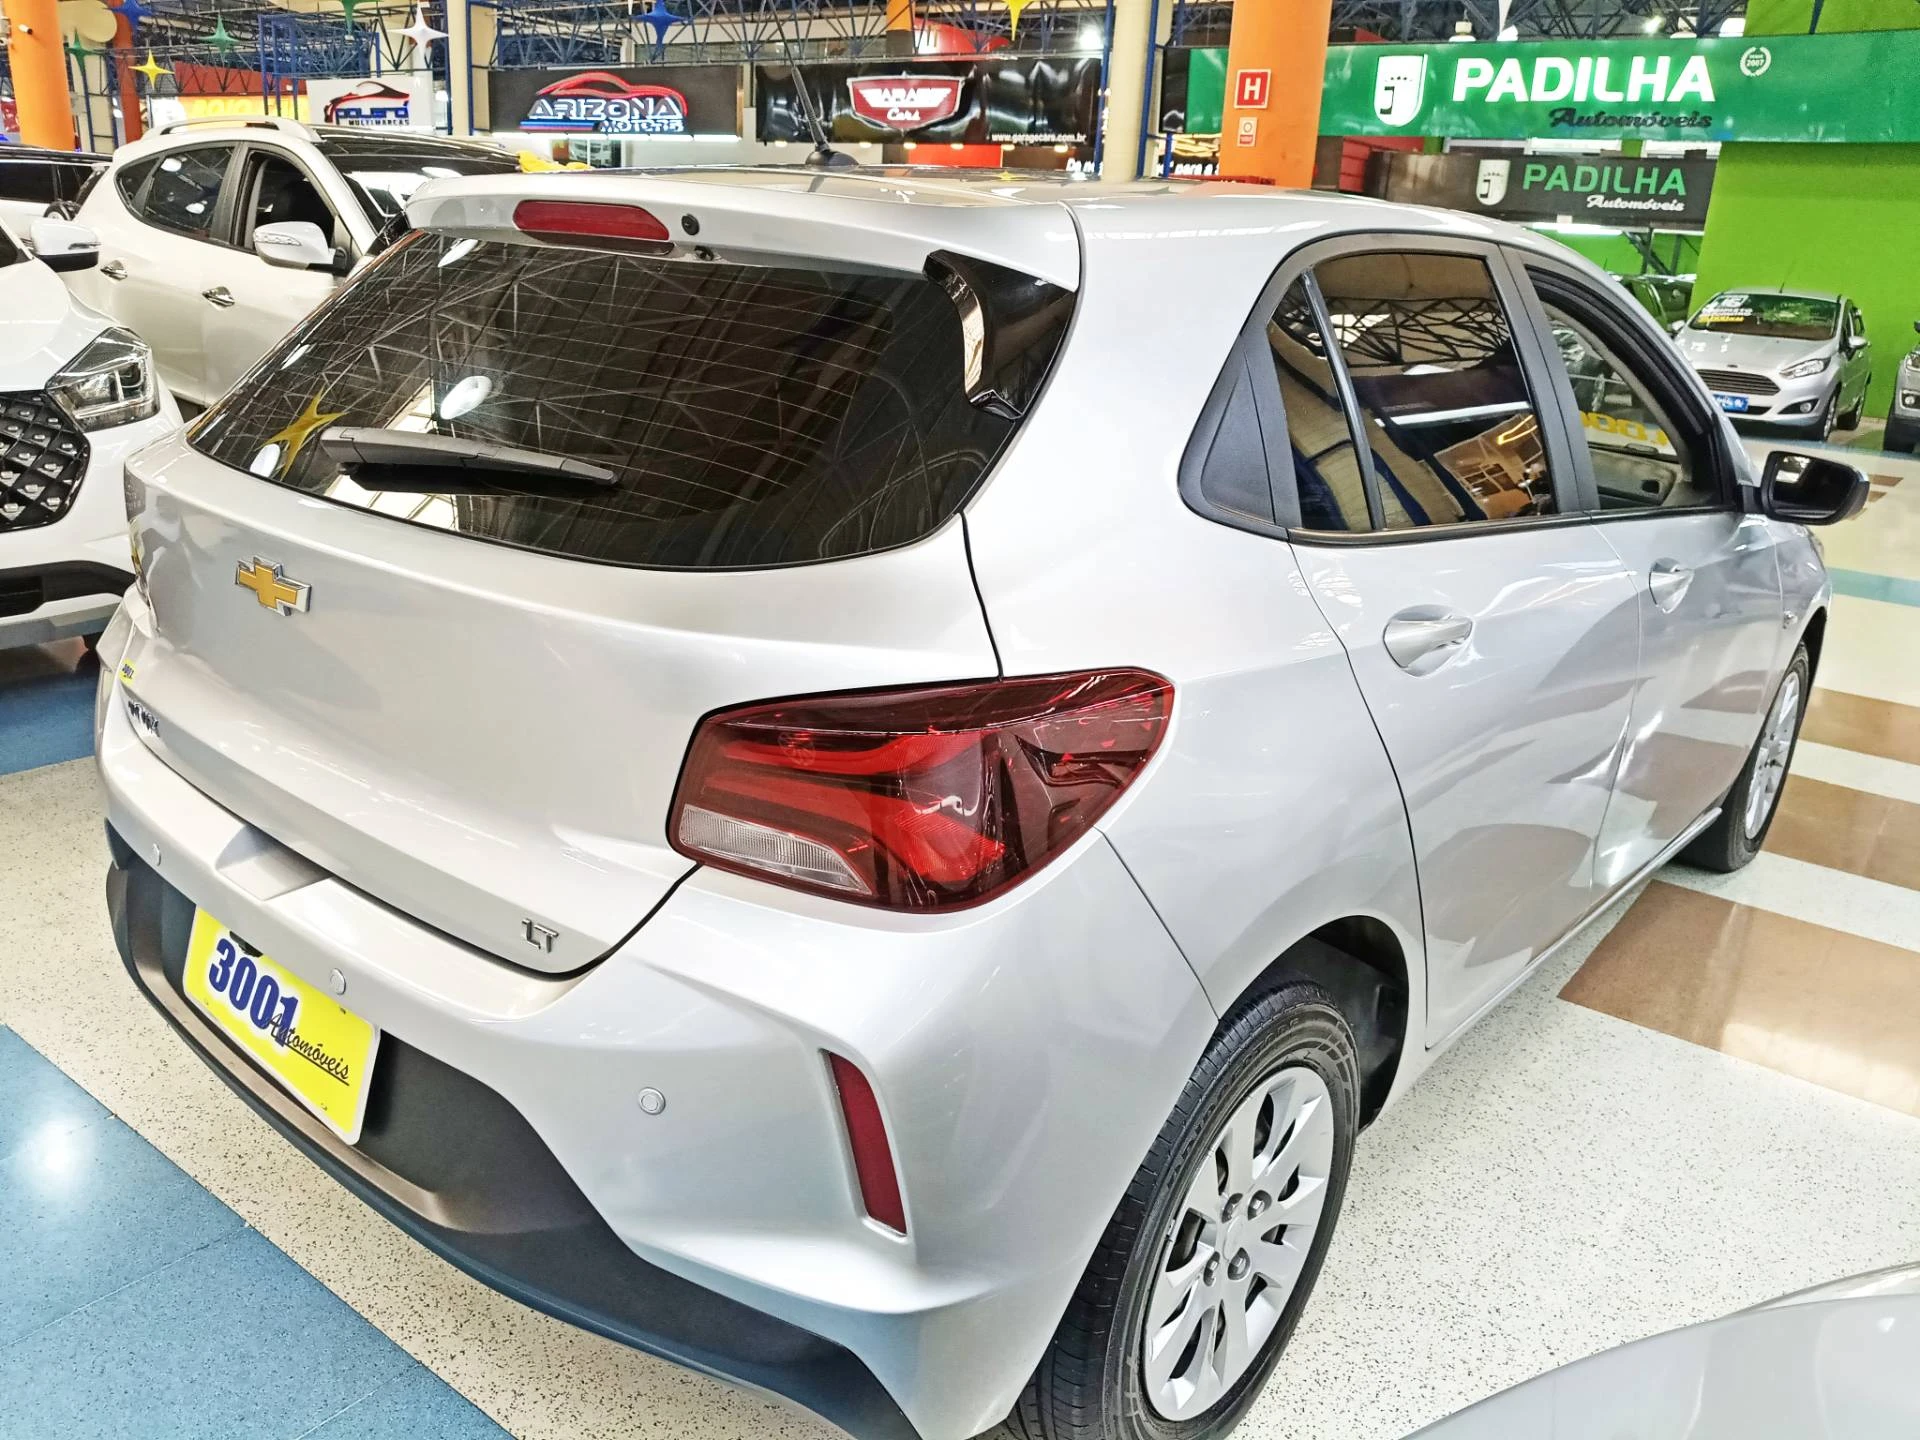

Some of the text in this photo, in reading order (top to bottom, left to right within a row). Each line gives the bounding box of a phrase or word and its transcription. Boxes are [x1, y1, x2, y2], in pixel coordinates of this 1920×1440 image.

[1243, 77, 1262, 101] H
[1452, 55, 1716, 102] PADILHA
[527, 97, 685, 120] ARIZONA
[1547, 107, 1713, 128] Automóveis
[1522, 163, 1687, 196] PADILHA
[1586, 194, 1685, 212] Automóveis
[521, 918, 560, 954] LT
[208, 937, 299, 1048] 3001
